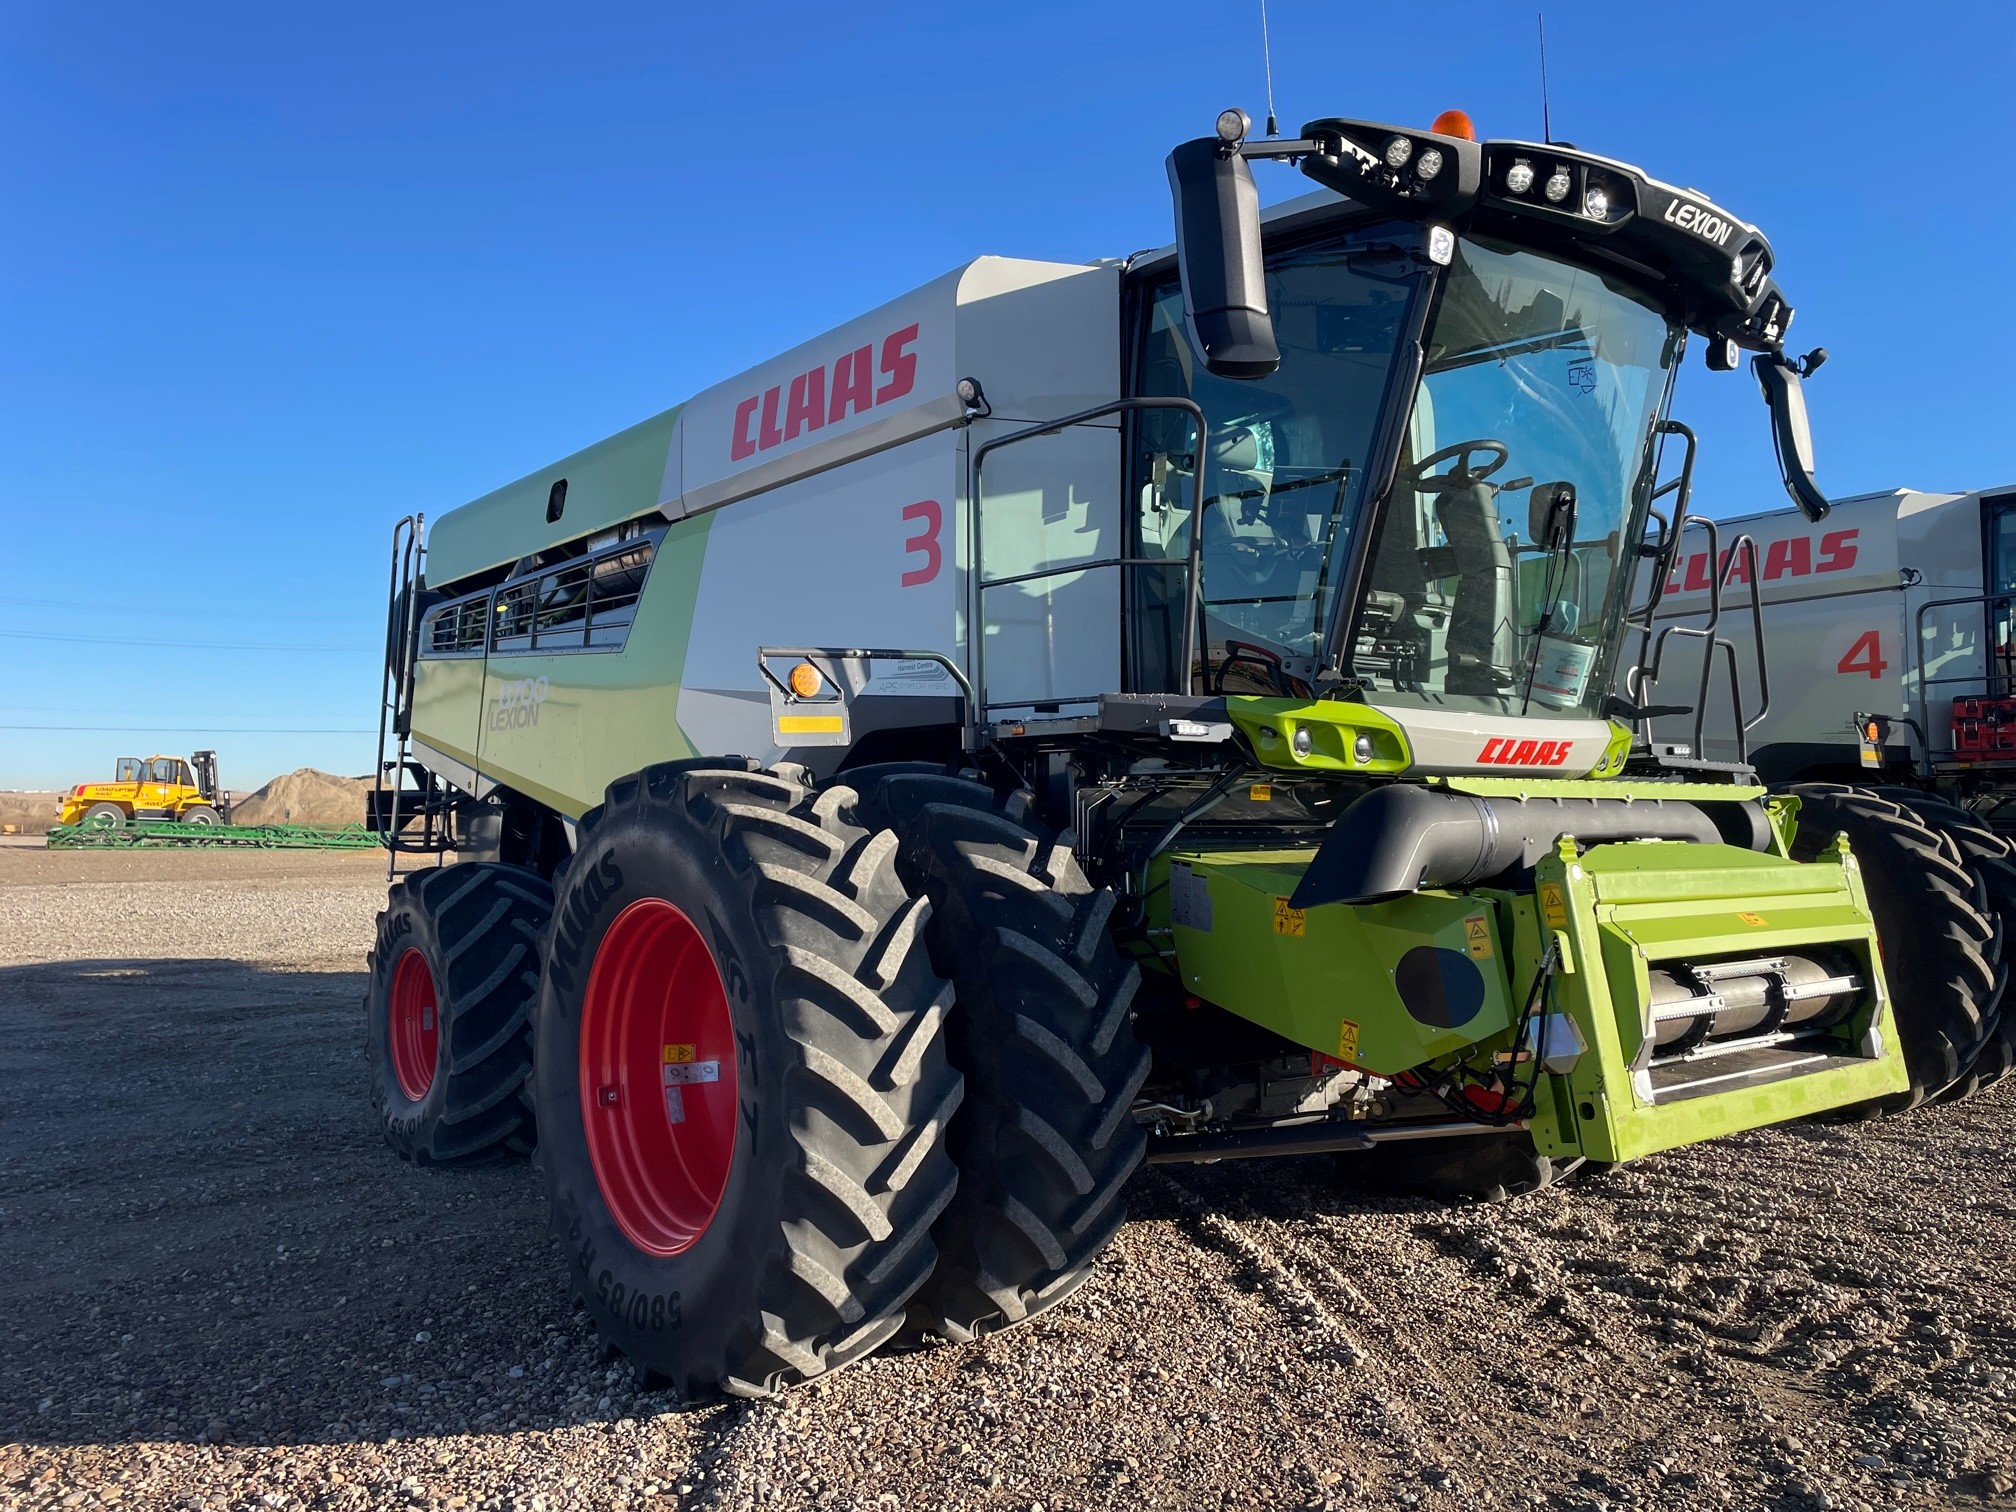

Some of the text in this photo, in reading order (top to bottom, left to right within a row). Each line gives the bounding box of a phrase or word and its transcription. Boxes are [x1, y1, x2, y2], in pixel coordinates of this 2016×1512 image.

[1665, 199, 1733, 246] LEXION
[731, 322, 919, 462] CLAAS
[902, 500, 942, 588] 3
[897, 661, 934, 672] Harvest Centre
[1838, 630, 1888, 679] 4
[489, 703, 540, 732] LEXION
[1476, 738, 1574, 765] CLAAS
[596, 1269, 683, 1334] 580/85
